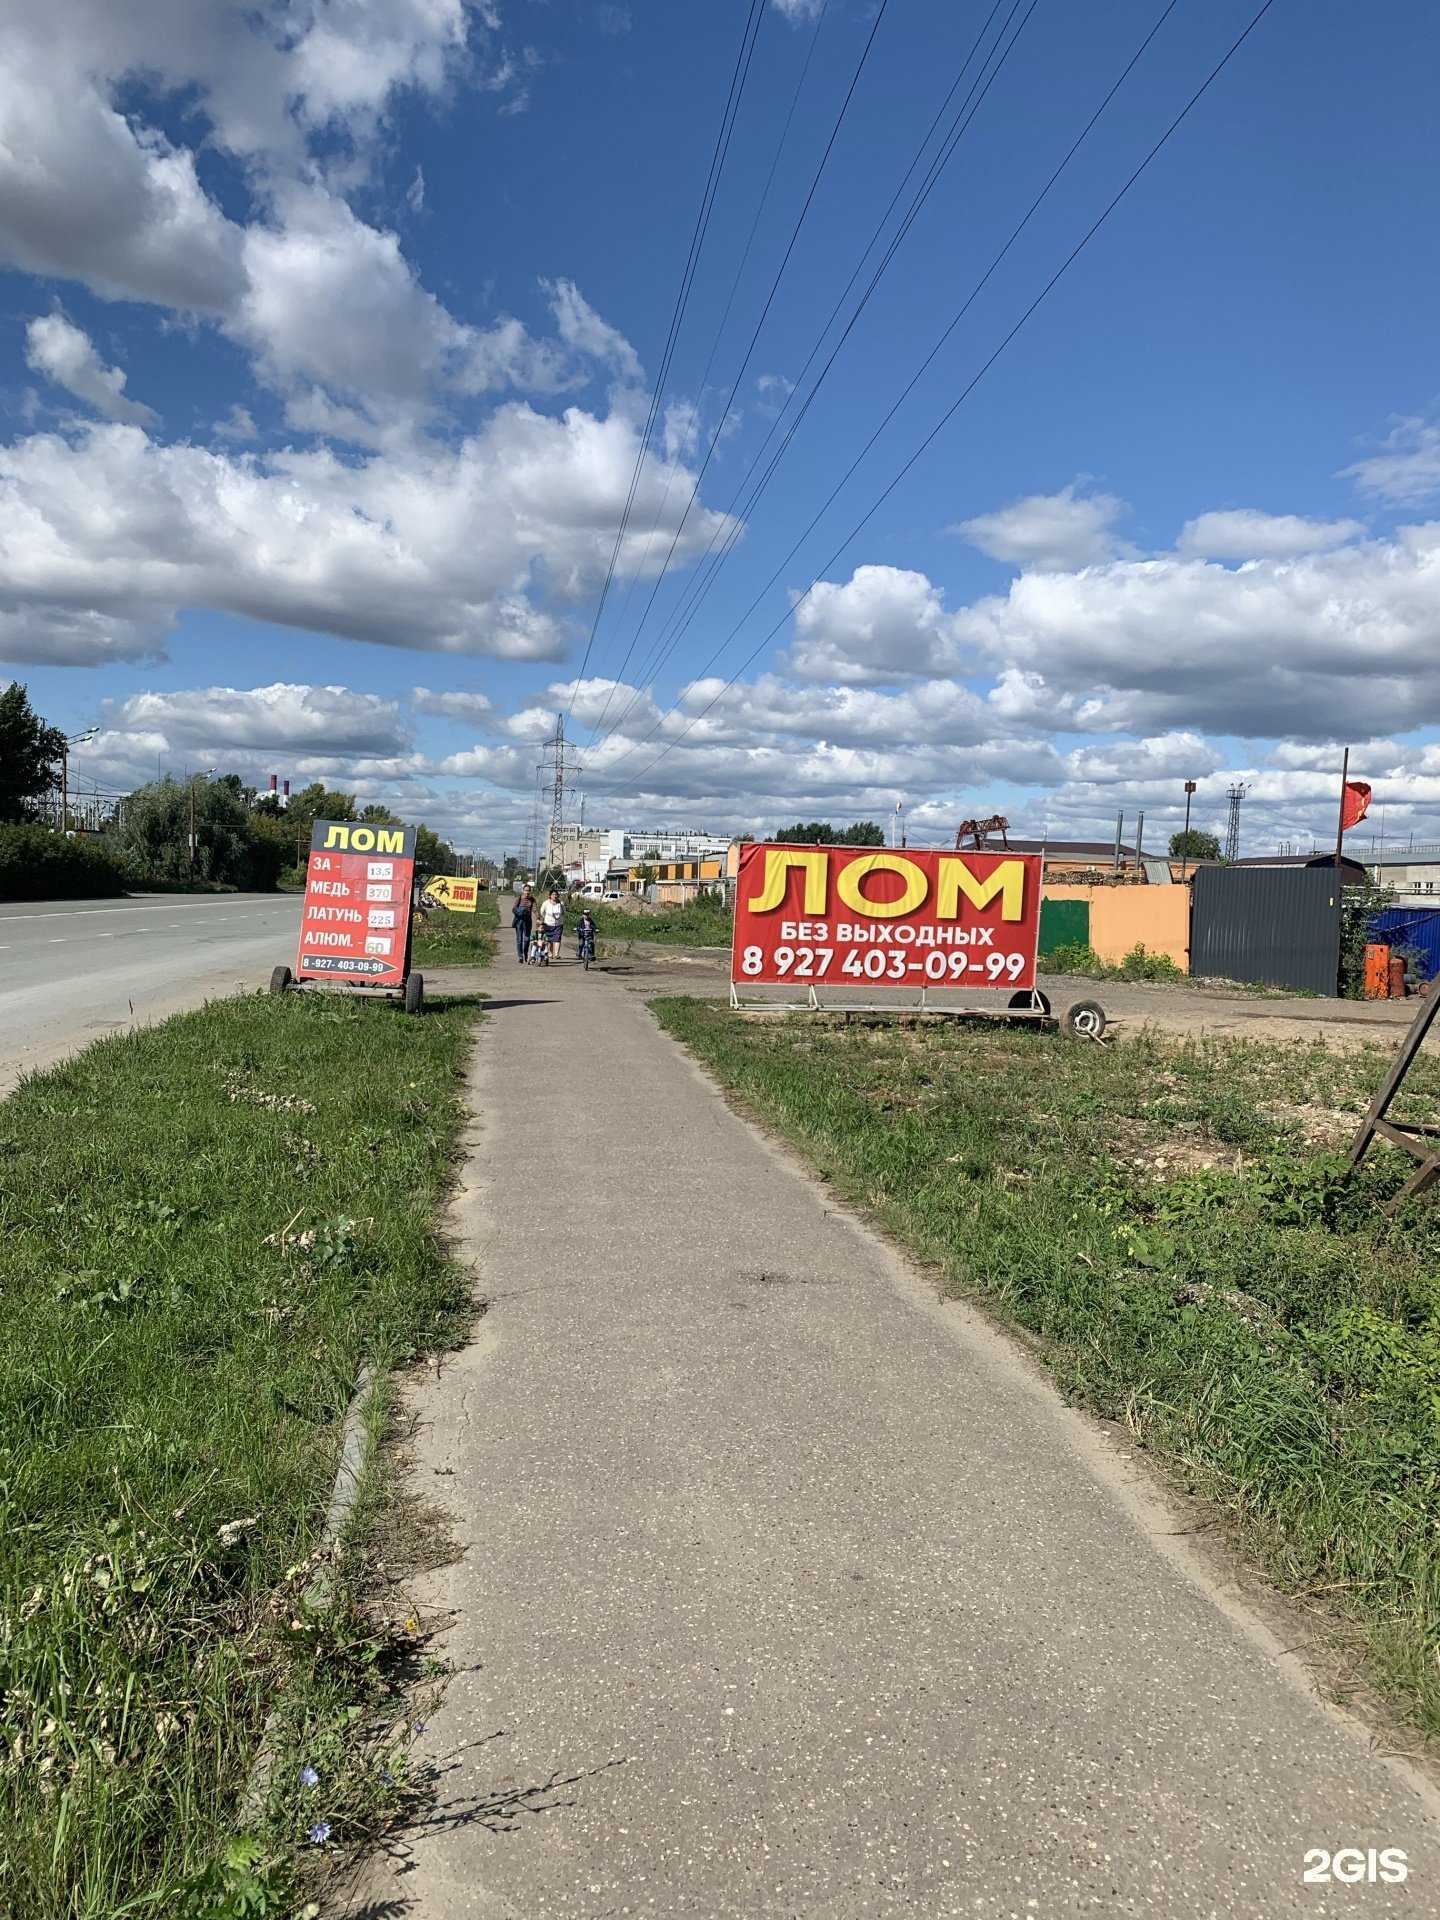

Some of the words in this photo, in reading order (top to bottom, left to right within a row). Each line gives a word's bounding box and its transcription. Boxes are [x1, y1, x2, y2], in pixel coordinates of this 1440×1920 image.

[324, 826, 404, 853] ЛОМ
[313, 858, 331, 870] ЗА
[310, 880, 350, 896] МЕДЬ
[368, 888, 390, 898] 370
[748, 850, 1025, 921] ЛОМ
[452, 890, 474, 901] ЛОМ
[307, 906, 362, 923] ЛАТУНЬ
[370, 915, 391, 924] 225
[304, 932, 353, 947] АЛЮМ.
[781, 921, 828, 941] БЕЗ
[836, 923, 994, 947] ВЫХОДНЫХ
[303, 958, 309, 967] 8
[337, 960, 384, 972] 403-09-99
[742, 945, 763, 975] 8
[773, 946, 834, 977] 927
[841, 949, 1025, 981] 403-09-99
